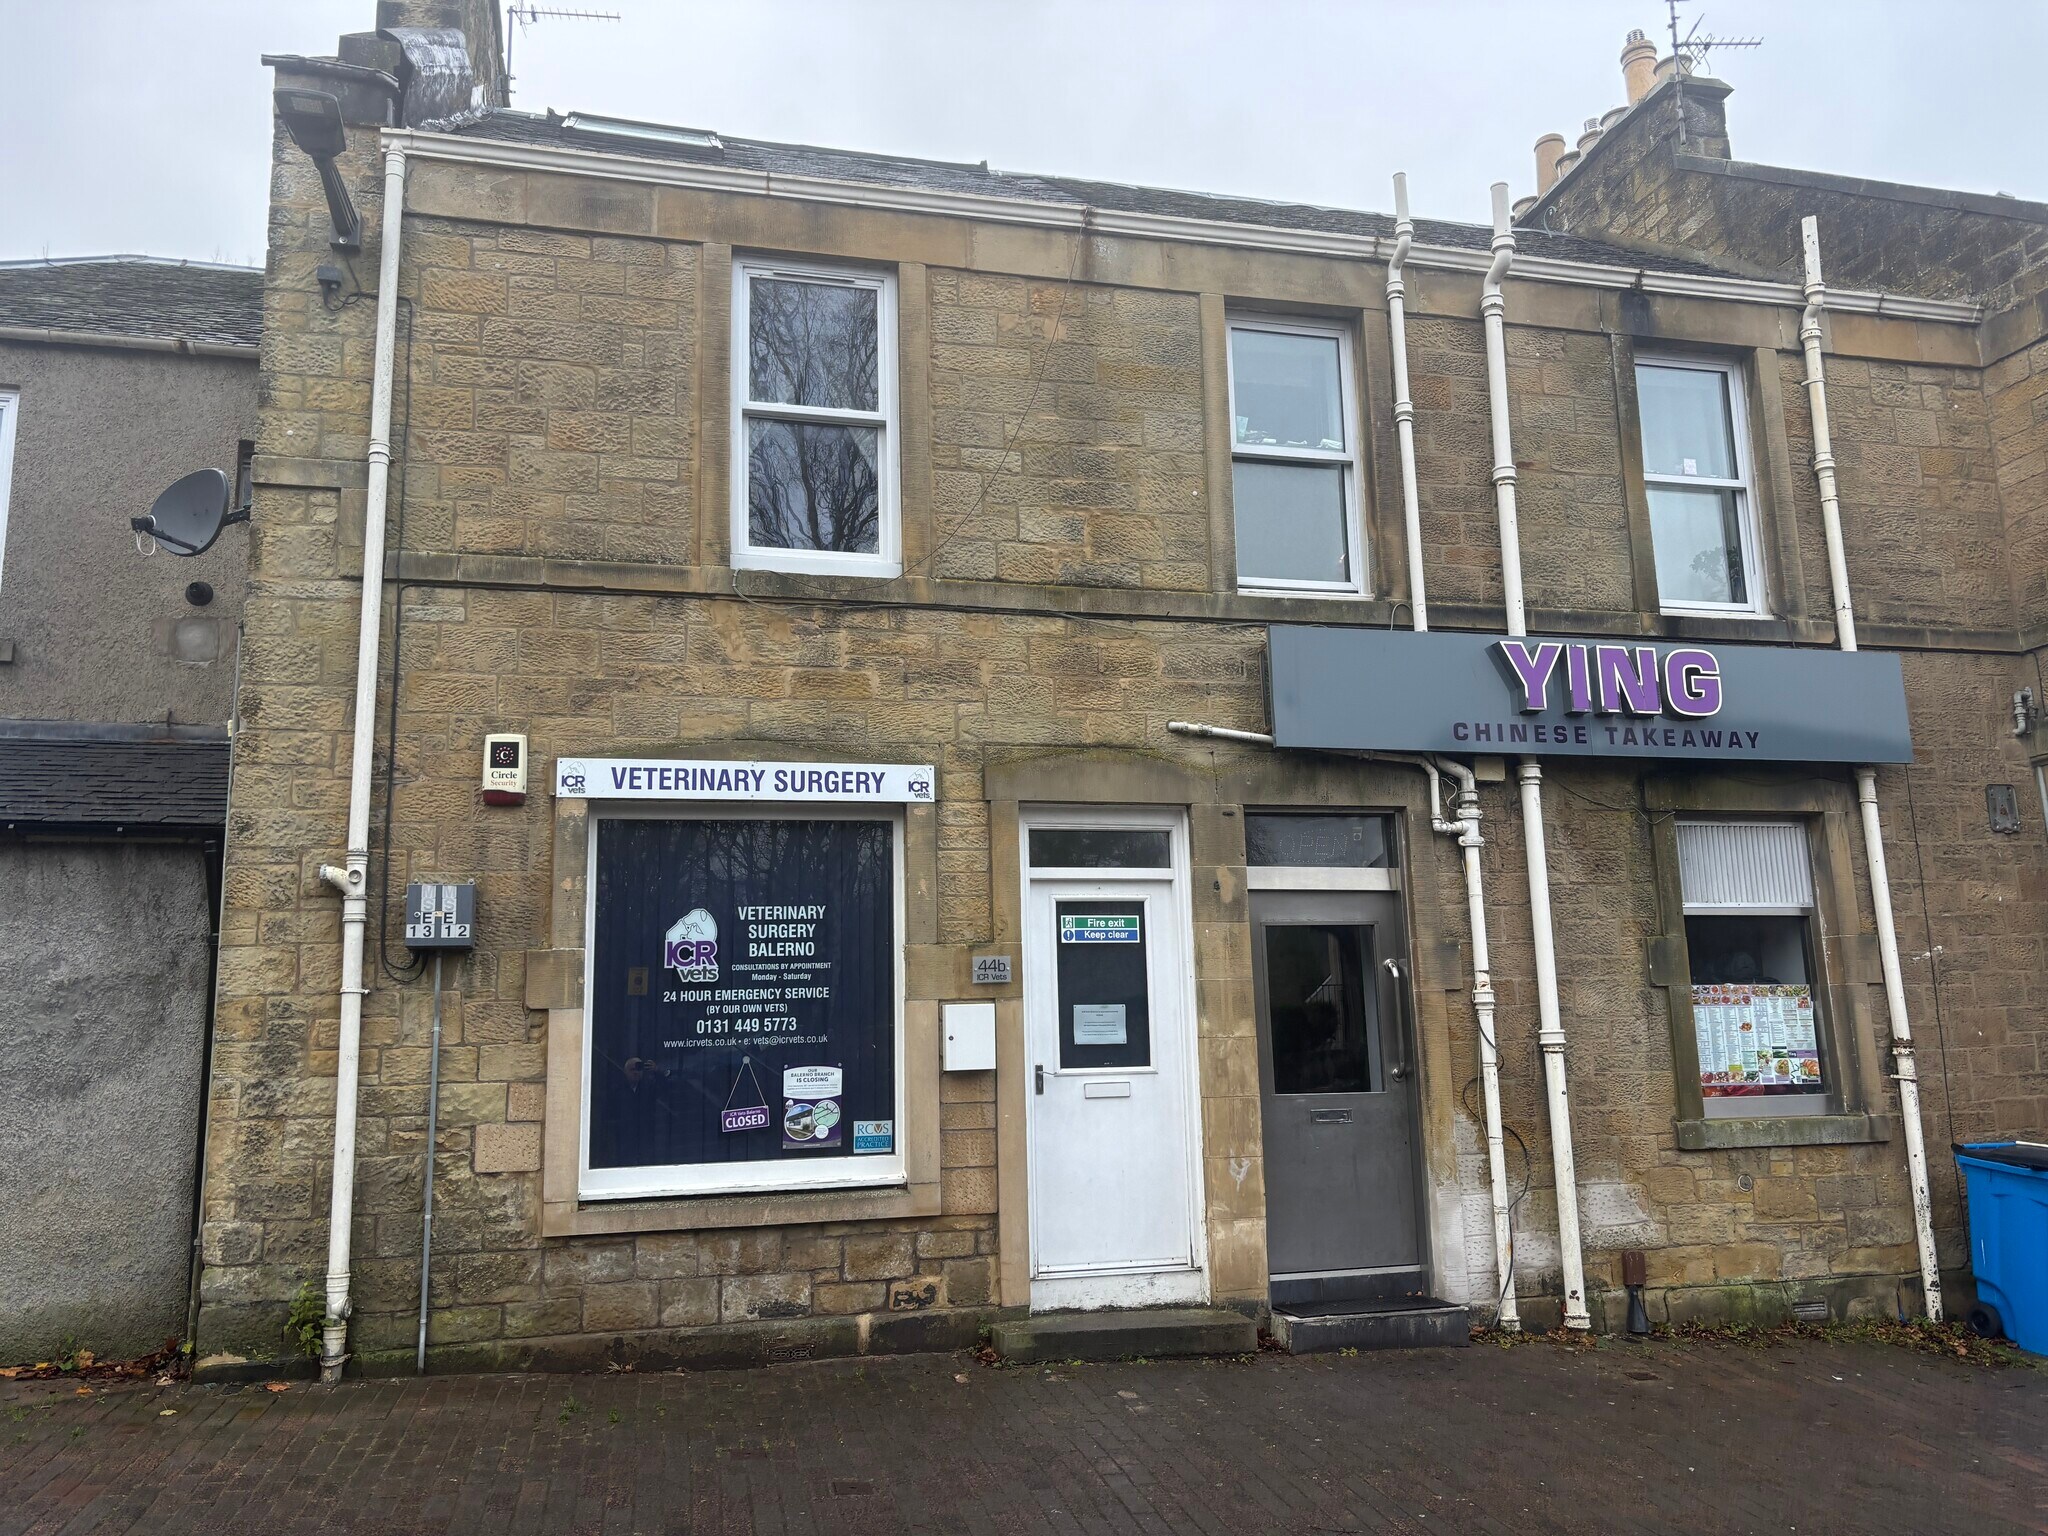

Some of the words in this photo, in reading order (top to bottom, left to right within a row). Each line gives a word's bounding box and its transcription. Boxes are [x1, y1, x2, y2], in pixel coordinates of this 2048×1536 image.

[1499, 640, 1723, 717] YING
[1453, 722, 1588, 744] CHINESE
[1605, 727, 1760, 749] TAKEAWAY
[491, 770, 518, 779] Circle
[561, 775, 586, 788] ICR
[611, 766, 766, 792] VETERINARY
[774, 769, 886, 794] SURGERY
[908, 781, 930, 792] ICR
[914, 791, 931, 799] vets
[1280, 833, 1348, 856] OPEN
[738, 905, 827, 921] VETERINARY
[1087, 918, 1106, 928] Fire
[1107, 918, 1125, 928] exit
[748, 923, 816, 939] SURGERY
[1084, 930, 1106, 940] Keep
[1107, 930, 1129, 939] clear
[664, 940, 718, 968] ICR
[749, 941, 815, 957] BALERNO
[731, 963, 780, 971] CONSULTATIONS
[789, 962, 832, 970] APPOINTMENT
[977, 959, 1006, 972] 44b
[678, 966, 719, 982] vets
[751, 973, 777, 982] Monday
[783, 972, 812, 981] Saturday
[976, 973, 990, 981] ICR
[991, 973, 1008, 981] Vets
[663, 991, 677, 1003] 24
[680, 989, 712, 1002] HOUR
[714, 988, 782, 1001] EMERGENCY
[784, 987, 830, 999] SERVICE
[706, 1004, 720, 1016] (BY
[723, 1004, 741, 1014] OUR
[742, 1004, 763, 1013] OWN
[764, 1003, 788, 1014] VETS)
[696, 1019, 729, 1034] 0131
[734, 1018, 760, 1033] 449
[763, 1016, 797, 1031] 5773
[663, 1037, 737, 1048] www.icrvets.co.uk
[753, 1034, 828, 1046] vets@icrvets.co.uk
[725, 1113, 766, 1129] CLOSED
